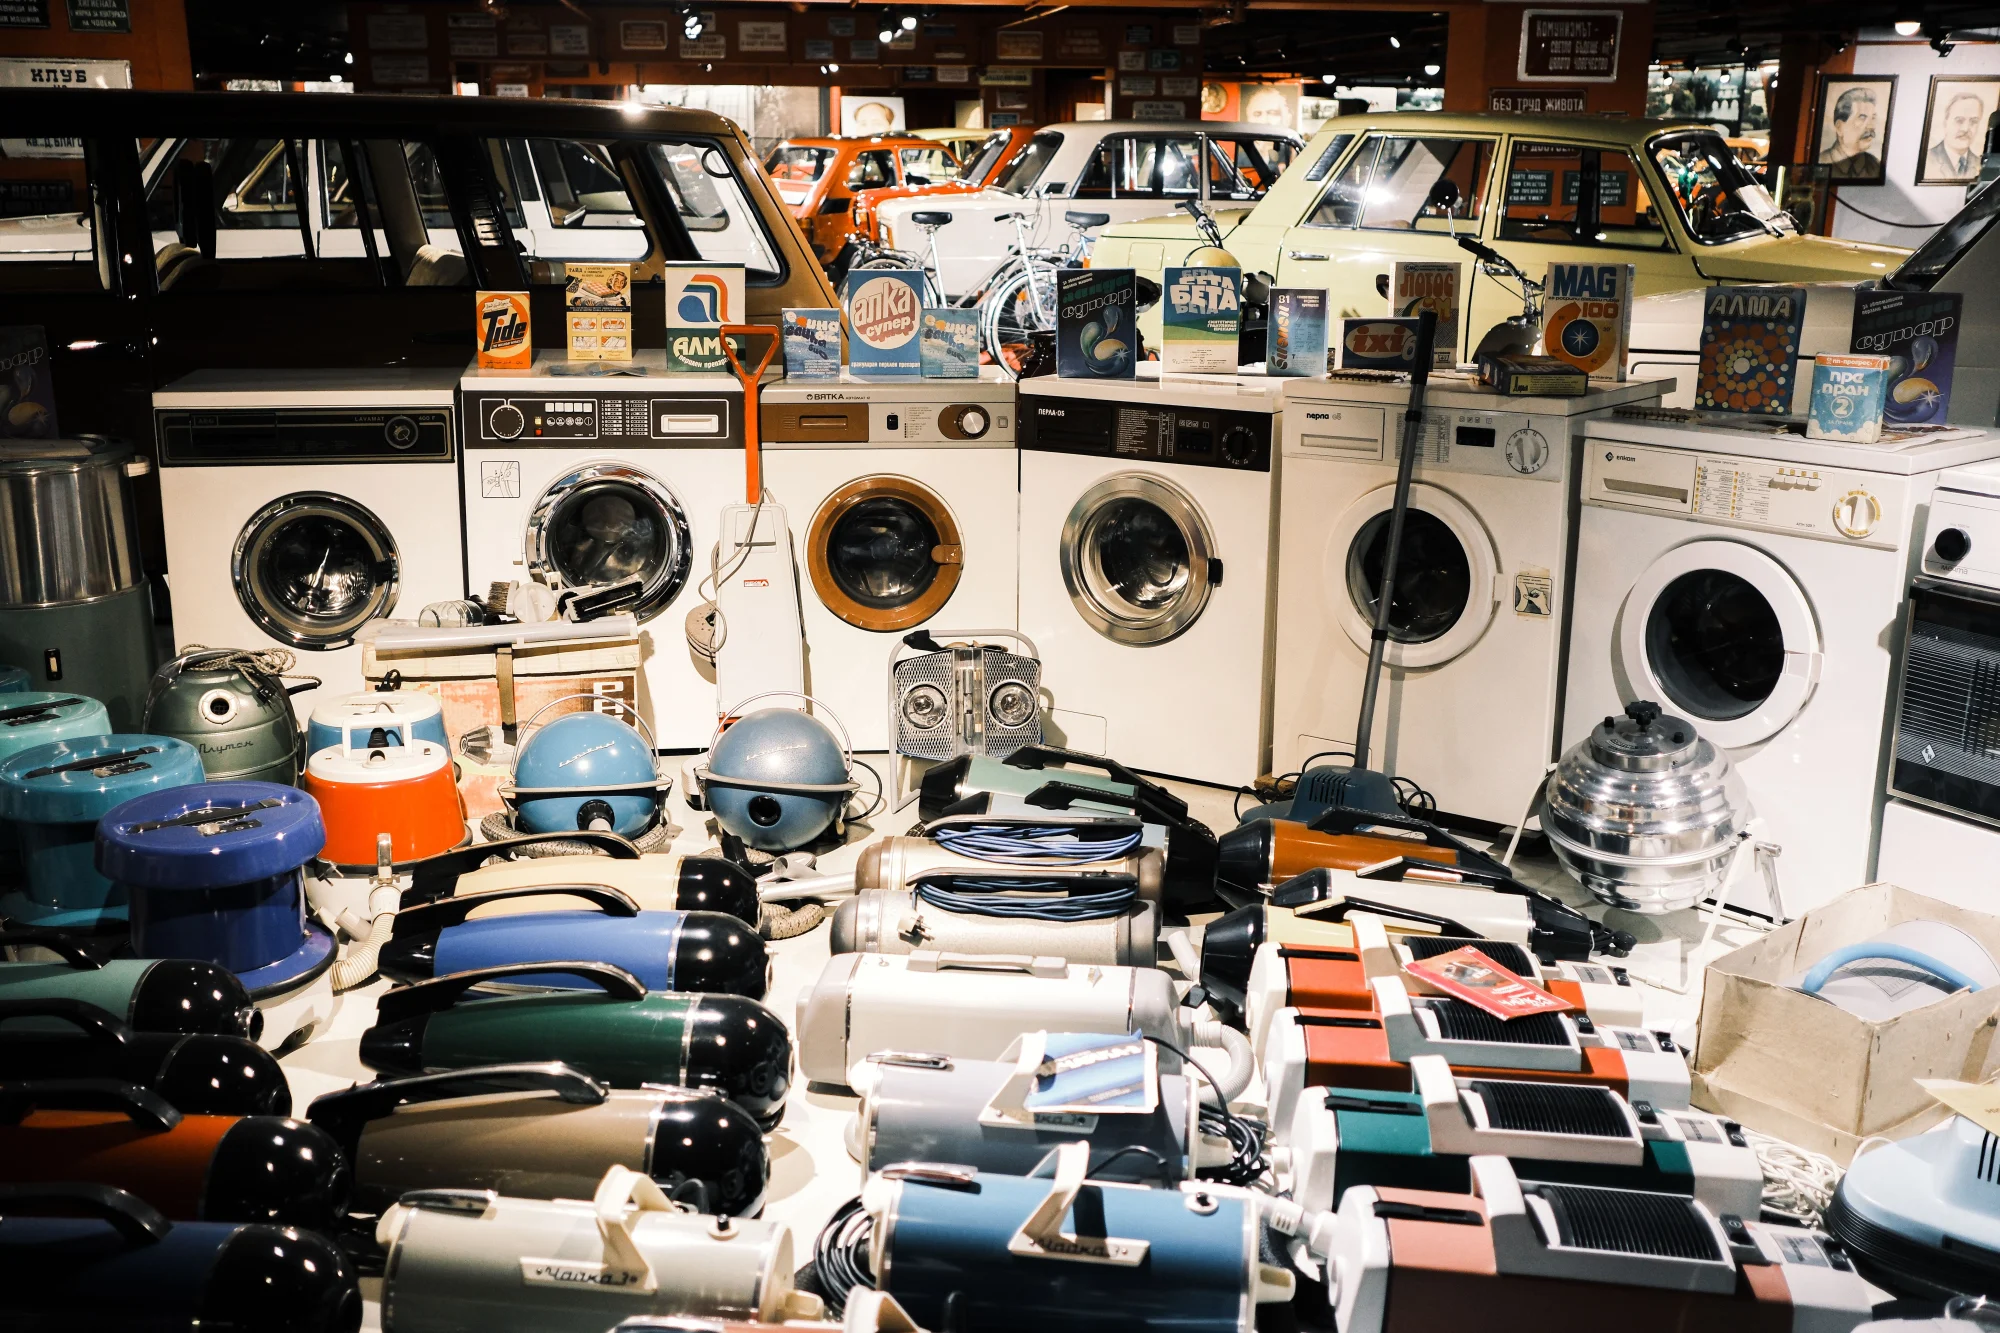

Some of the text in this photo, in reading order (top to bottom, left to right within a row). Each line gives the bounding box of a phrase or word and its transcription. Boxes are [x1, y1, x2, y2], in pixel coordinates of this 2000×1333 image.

[30, 69, 87, 82] КЛУБ
[1492, 98, 1584, 112] БЕЗ ТРУД ЖИВОТА
[1400, 272, 1454, 298] ЛОТОС
[1553, 265, 1617, 298] MAG
[1170, 284, 1238, 311] БЕТА
[1278, 294, 1290, 304] 81
[1707, 294, 1791, 318] АЛМА
[1581, 302, 1619, 319] 100
[483, 308, 528, 352] Tide
[866, 315, 911, 337] супер
[1353, 326, 1407, 353] ixi
[1829, 371, 1865, 385] пре
[814, 393, 845, 401] ВЯТКА
[1822, 383, 1870, 396] пран
[1835, 398, 1849, 415] 2
[545, 1266, 612, 1285] Чайка
